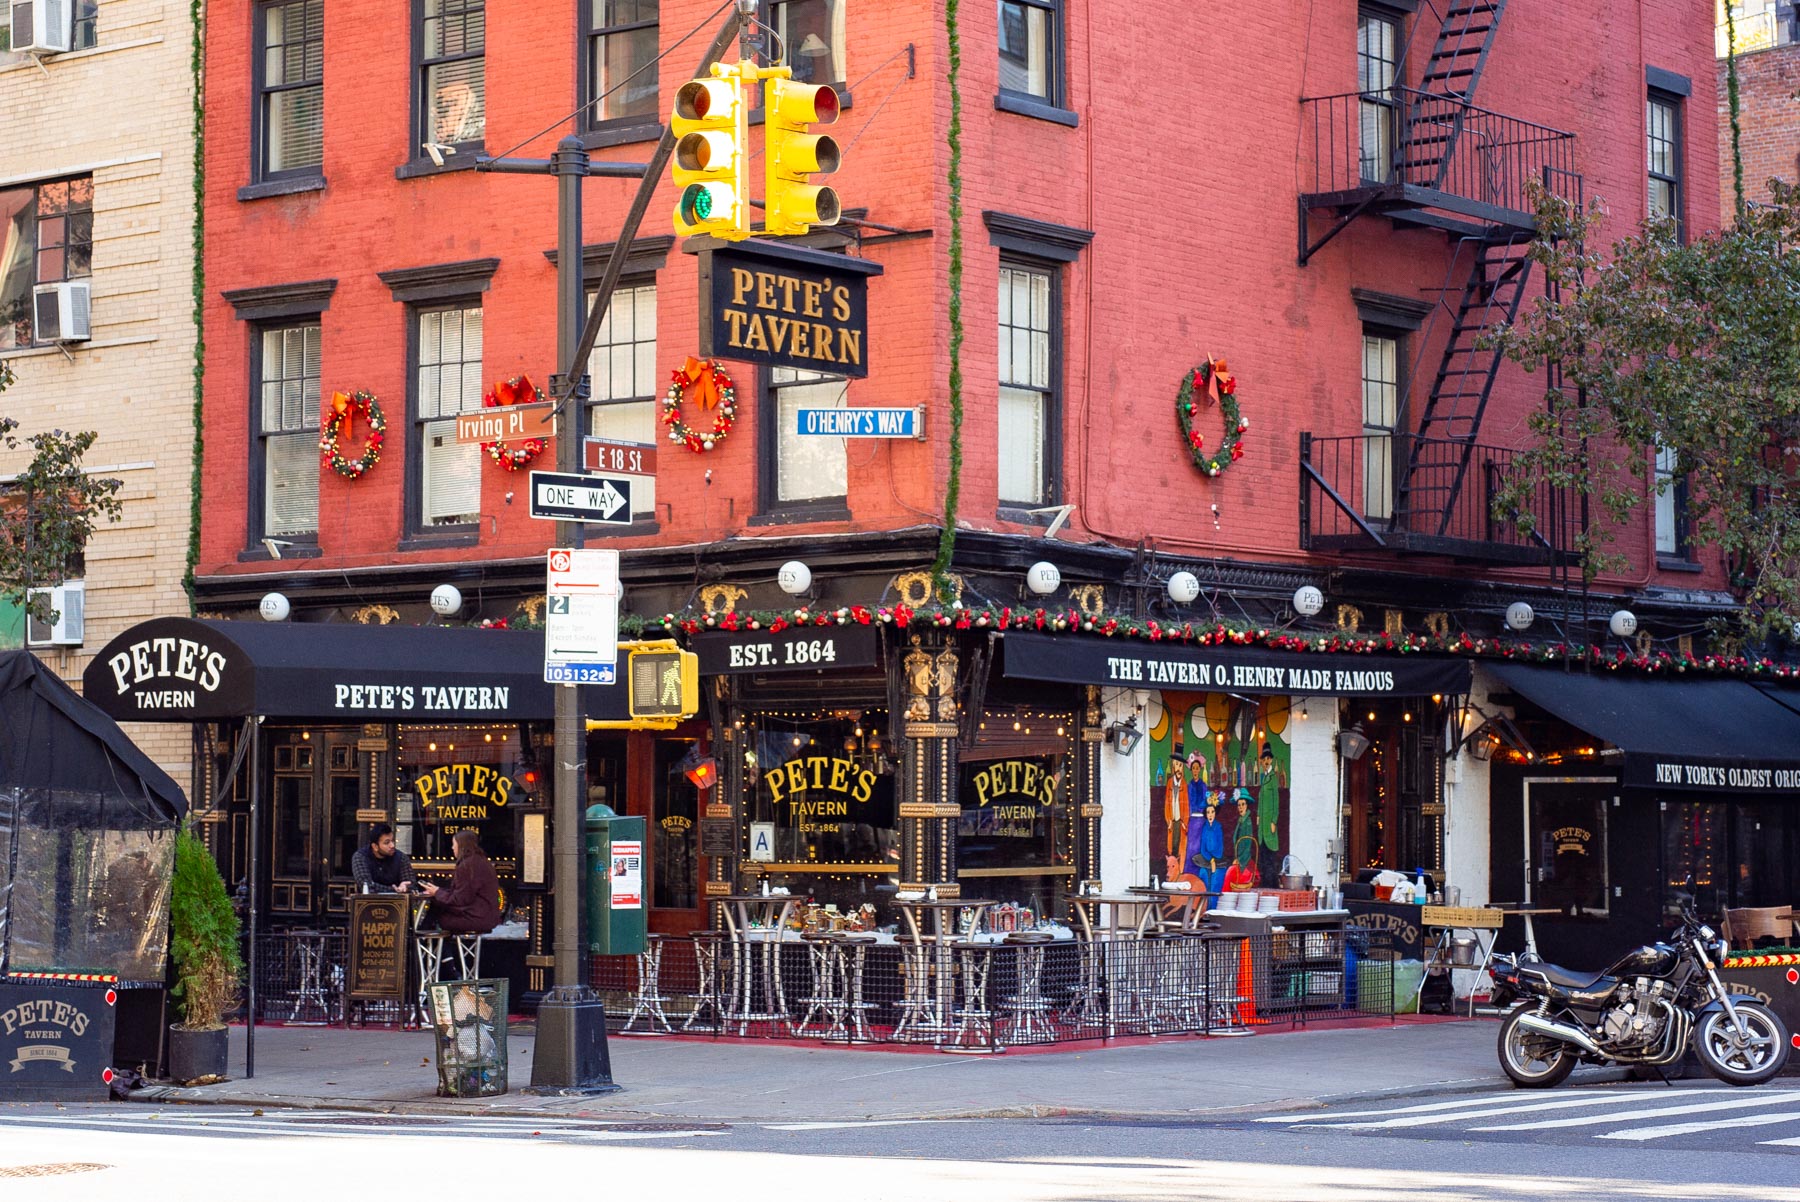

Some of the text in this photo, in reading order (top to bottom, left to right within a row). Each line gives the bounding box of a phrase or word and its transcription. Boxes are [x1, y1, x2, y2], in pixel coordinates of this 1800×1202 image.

[731, 268, 851, 321] PETE'S
[723, 309, 861, 365] TAVERN
[459, 412, 524, 440] Irving Pl
[807, 411, 906, 433] O'HENRY'S WAY
[598, 447, 642, 473] E 18 St
[546, 487, 617, 509] ONE WAY
[729, 639, 836, 667] EST. 1864
[108, 638, 226, 695] PETE'S
[548, 668, 599, 681] 105132
[1108, 658, 1142, 681] THE
[1147, 660, 1210, 685] TAVERN
[1289, 669, 1331, 690] MADE
[1335, 670, 1394, 691] FAMOUS
[135, 691, 195, 708] TAVERN
[334, 684, 509, 710] PETE'S TAVERN
[415, 764, 512, 807] PETE'S
[764, 757, 877, 804] PETE'S
[972, 761, 1057, 807] PETE'S
[1656, 763, 1682, 783] NEW
[1685, 765, 1726, 786] YORK'S
[1728, 768, 1772, 788] OLDEST
[436, 805, 487, 818] TAVERN
[789, 801, 847, 815] TAVERN
[992, 805, 1036, 819] TAVERN
[661, 815, 692, 829] PETE'S
[819, 824, 839, 832] 1864
[755, 831, 769, 851] A
[1552, 826, 1591, 842] PETE'S
[361, 922, 397, 935] HAPPY
[363, 935, 394, 948] HOUR
[0, 1000, 90, 1036] PETE'S
[24, 1030, 62, 1039] TAVERN
